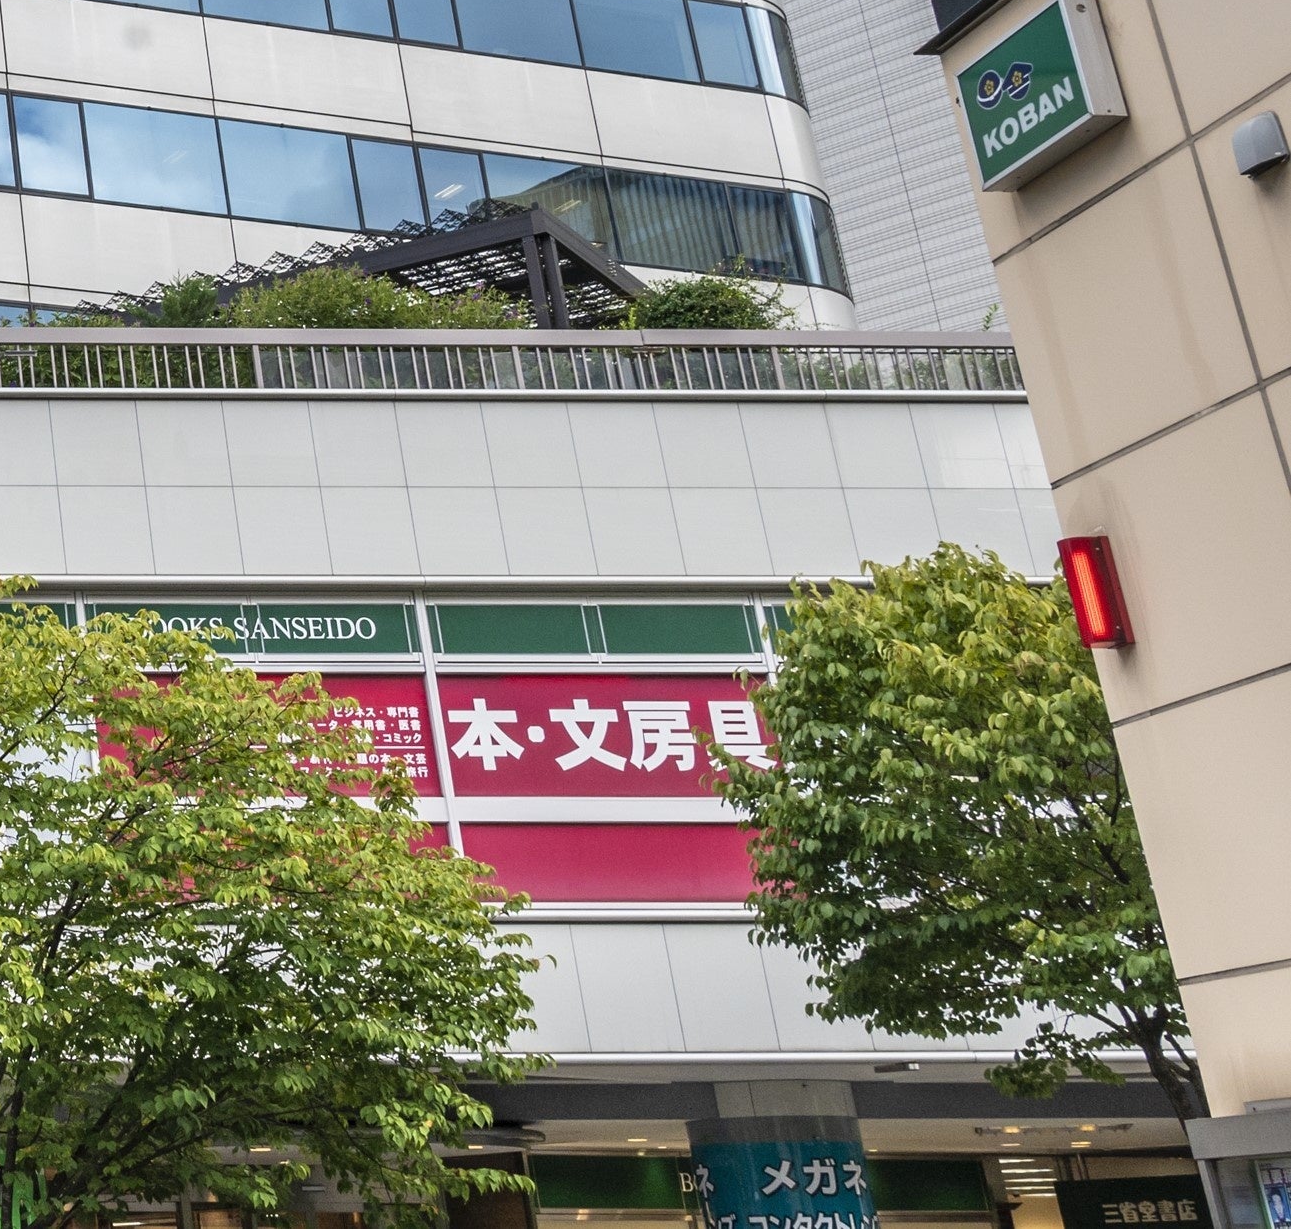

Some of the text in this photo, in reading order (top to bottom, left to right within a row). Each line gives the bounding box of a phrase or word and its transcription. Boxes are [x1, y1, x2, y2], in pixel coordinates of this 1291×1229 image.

[982, 76, 1074, 158] KOBAN
[127, 616, 376, 640] OOKS SANSEIDO
[447, 698, 777, 771] 本・文房具
[761, 1158, 867, 1196] メガネ
[1102, 1198, 1199, 1224] 三省堂書店
